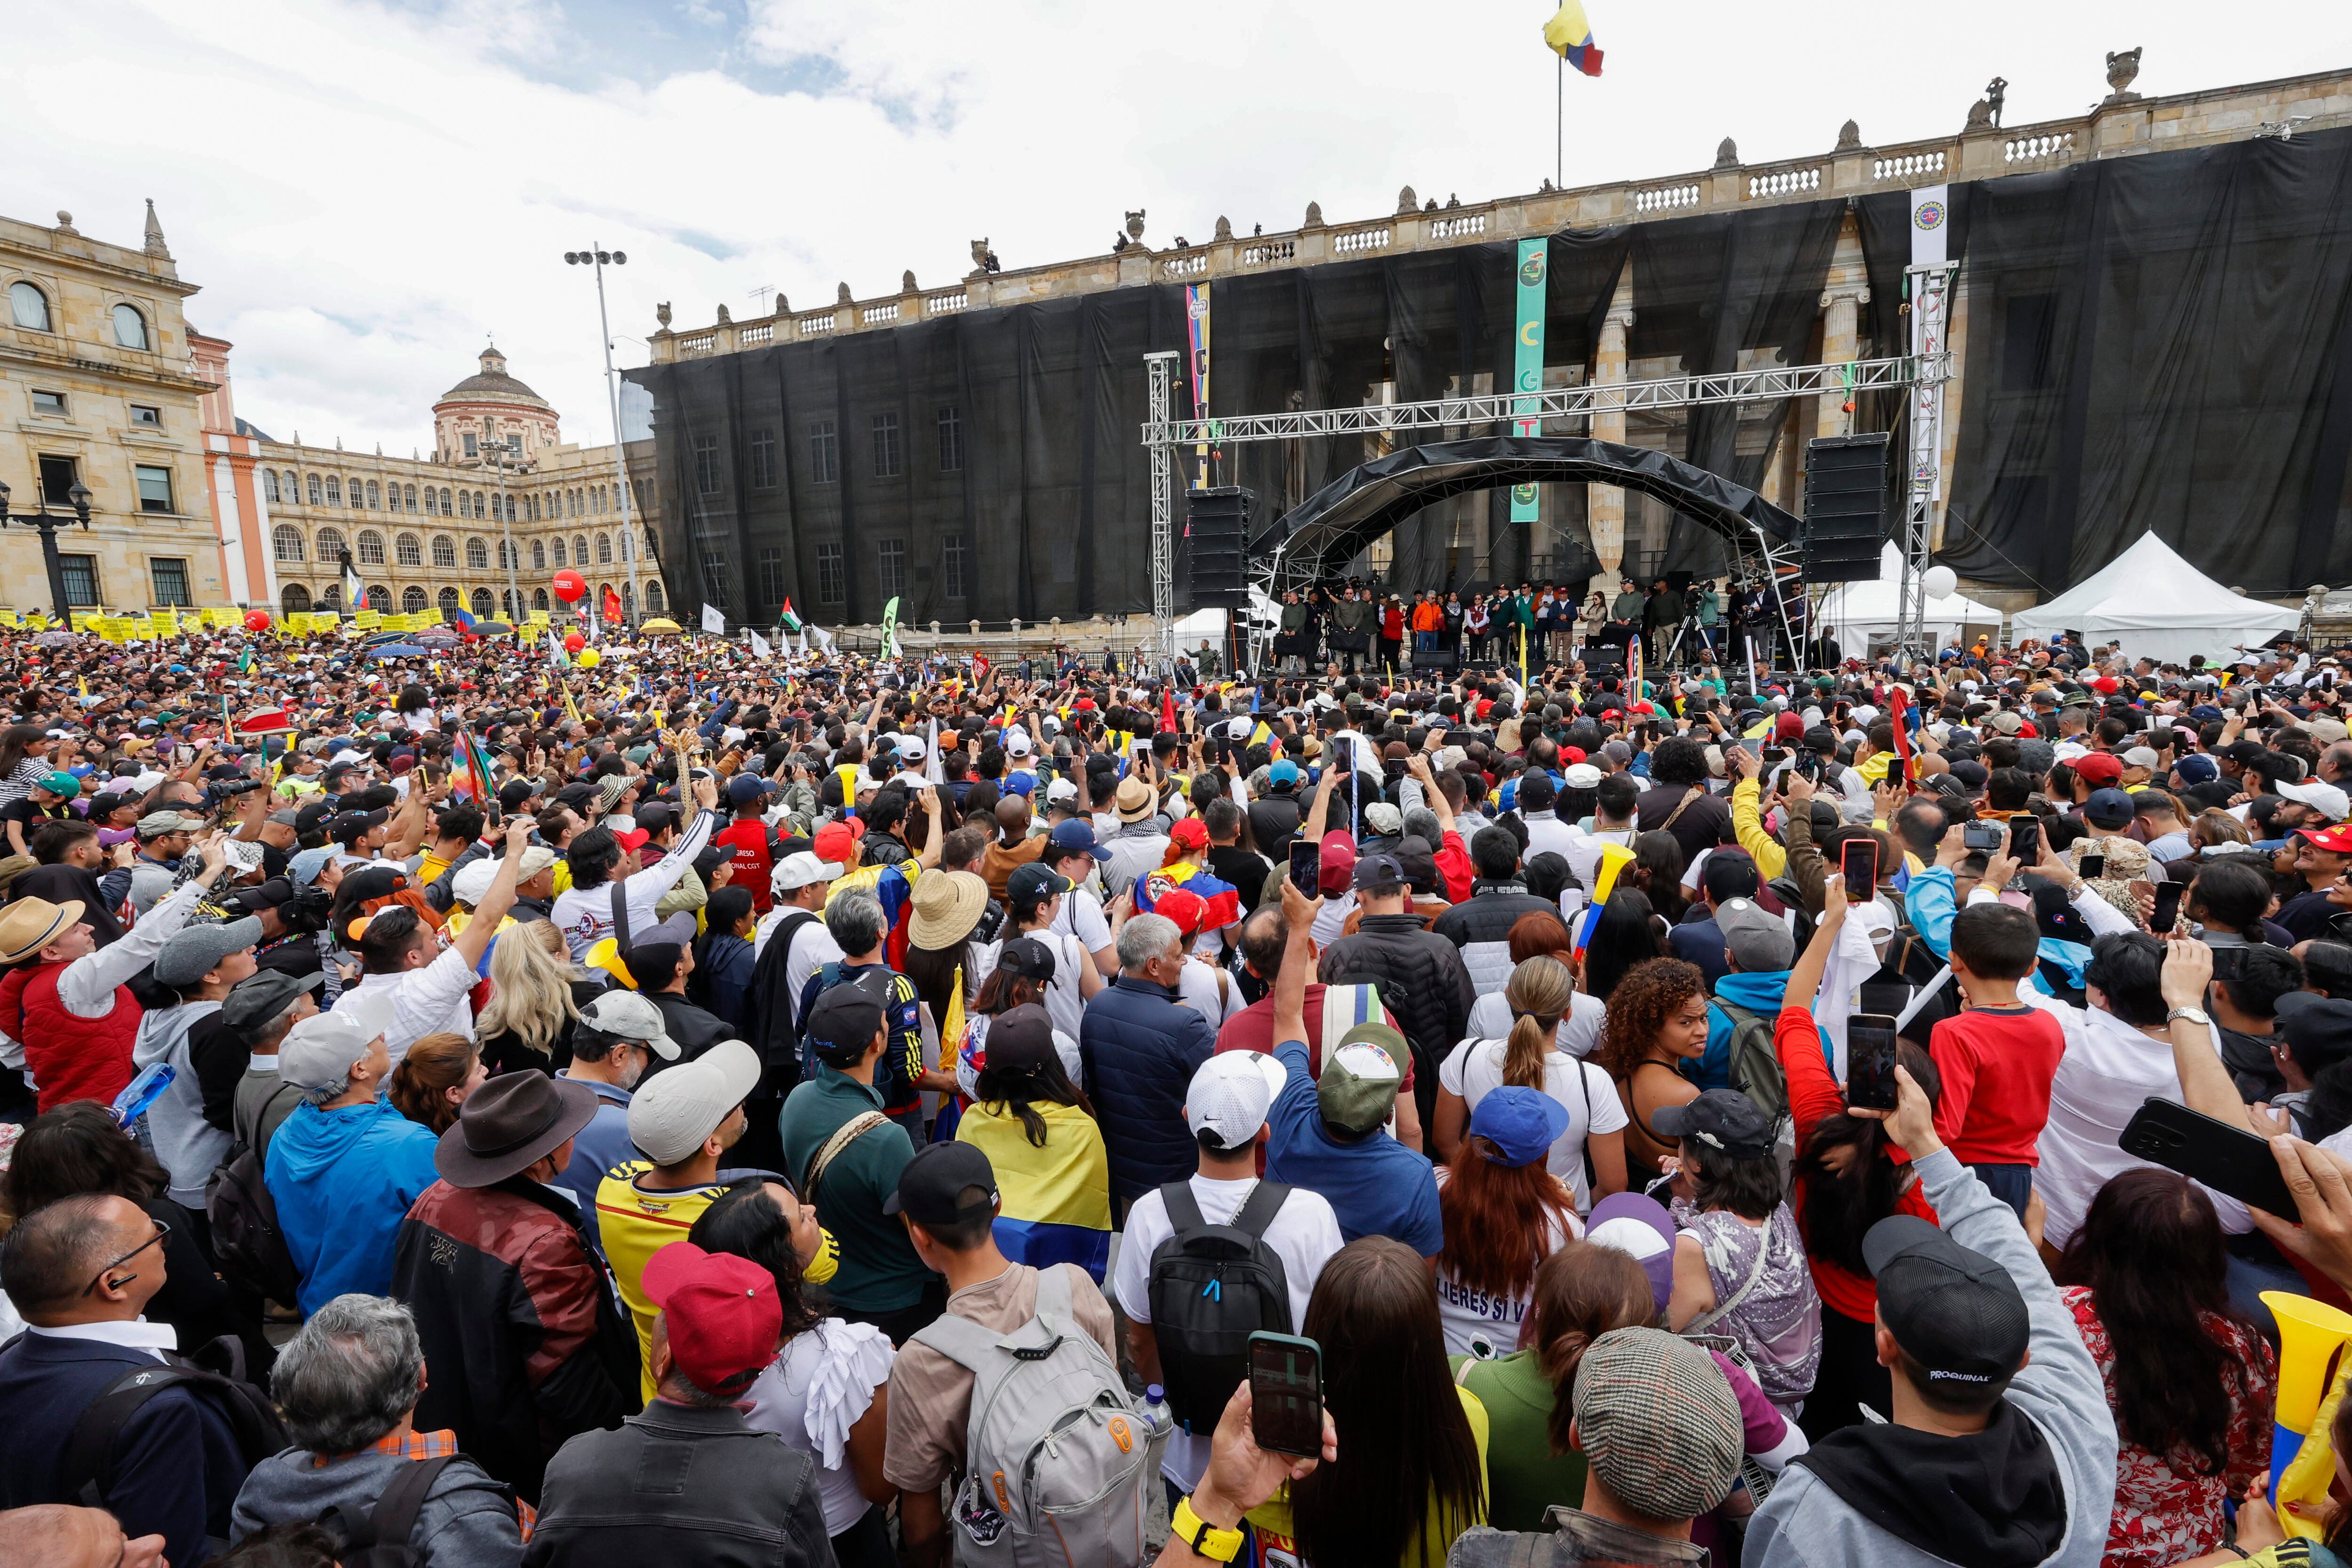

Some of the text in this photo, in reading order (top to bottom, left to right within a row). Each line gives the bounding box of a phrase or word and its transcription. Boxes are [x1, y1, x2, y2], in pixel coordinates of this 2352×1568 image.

[1921, 211, 1938, 220] CTC
[1436, 1278, 1488, 1317] LIERES
[1930, 1370, 1990, 1382] PROQUINAL
